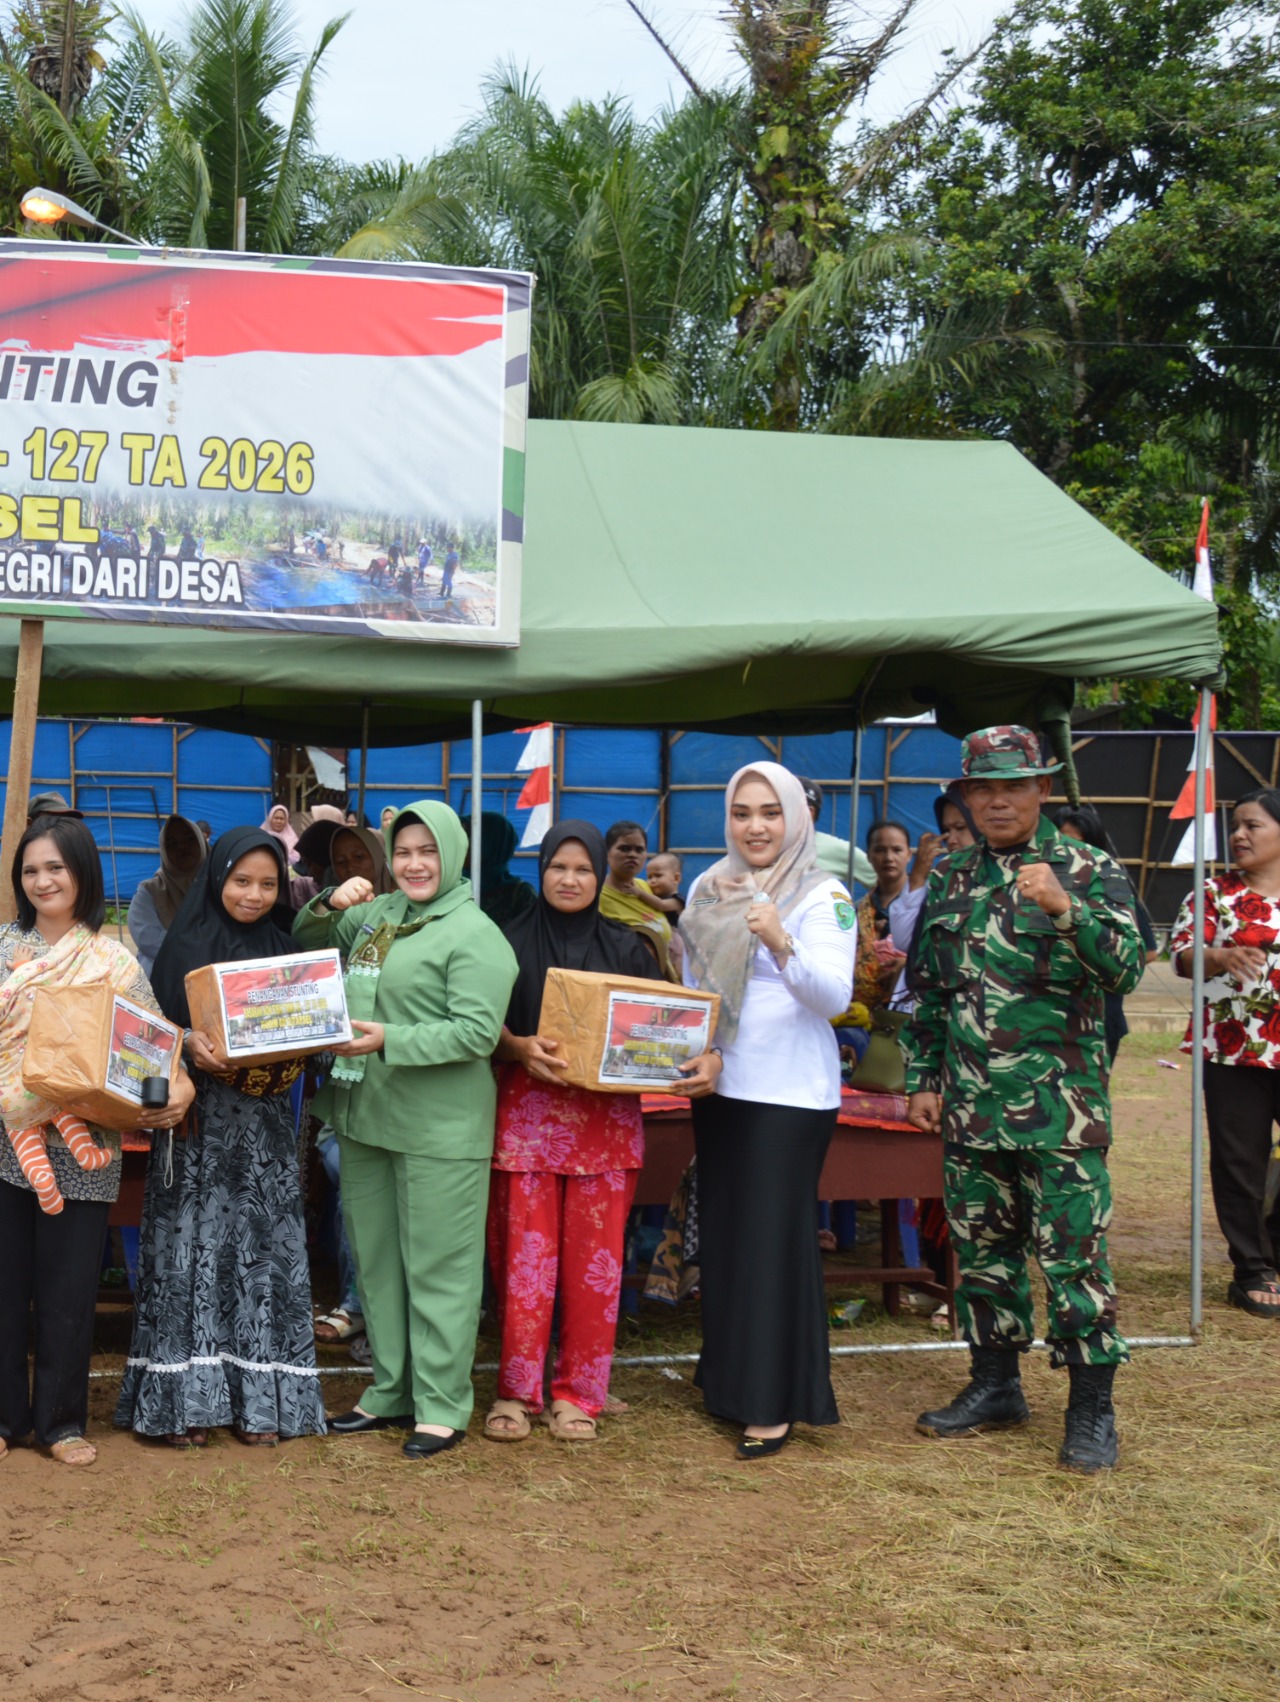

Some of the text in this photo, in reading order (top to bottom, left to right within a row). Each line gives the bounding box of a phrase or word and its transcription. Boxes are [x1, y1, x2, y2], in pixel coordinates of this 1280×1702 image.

[22, 427, 108, 483] 127
[121, 432, 186, 487] TA
[200, 437, 315, 494] 2026
[72, 554, 148, 598] DARI
[158, 559, 242, 603] DESA
[289, 983, 319, 998] STUNTING
